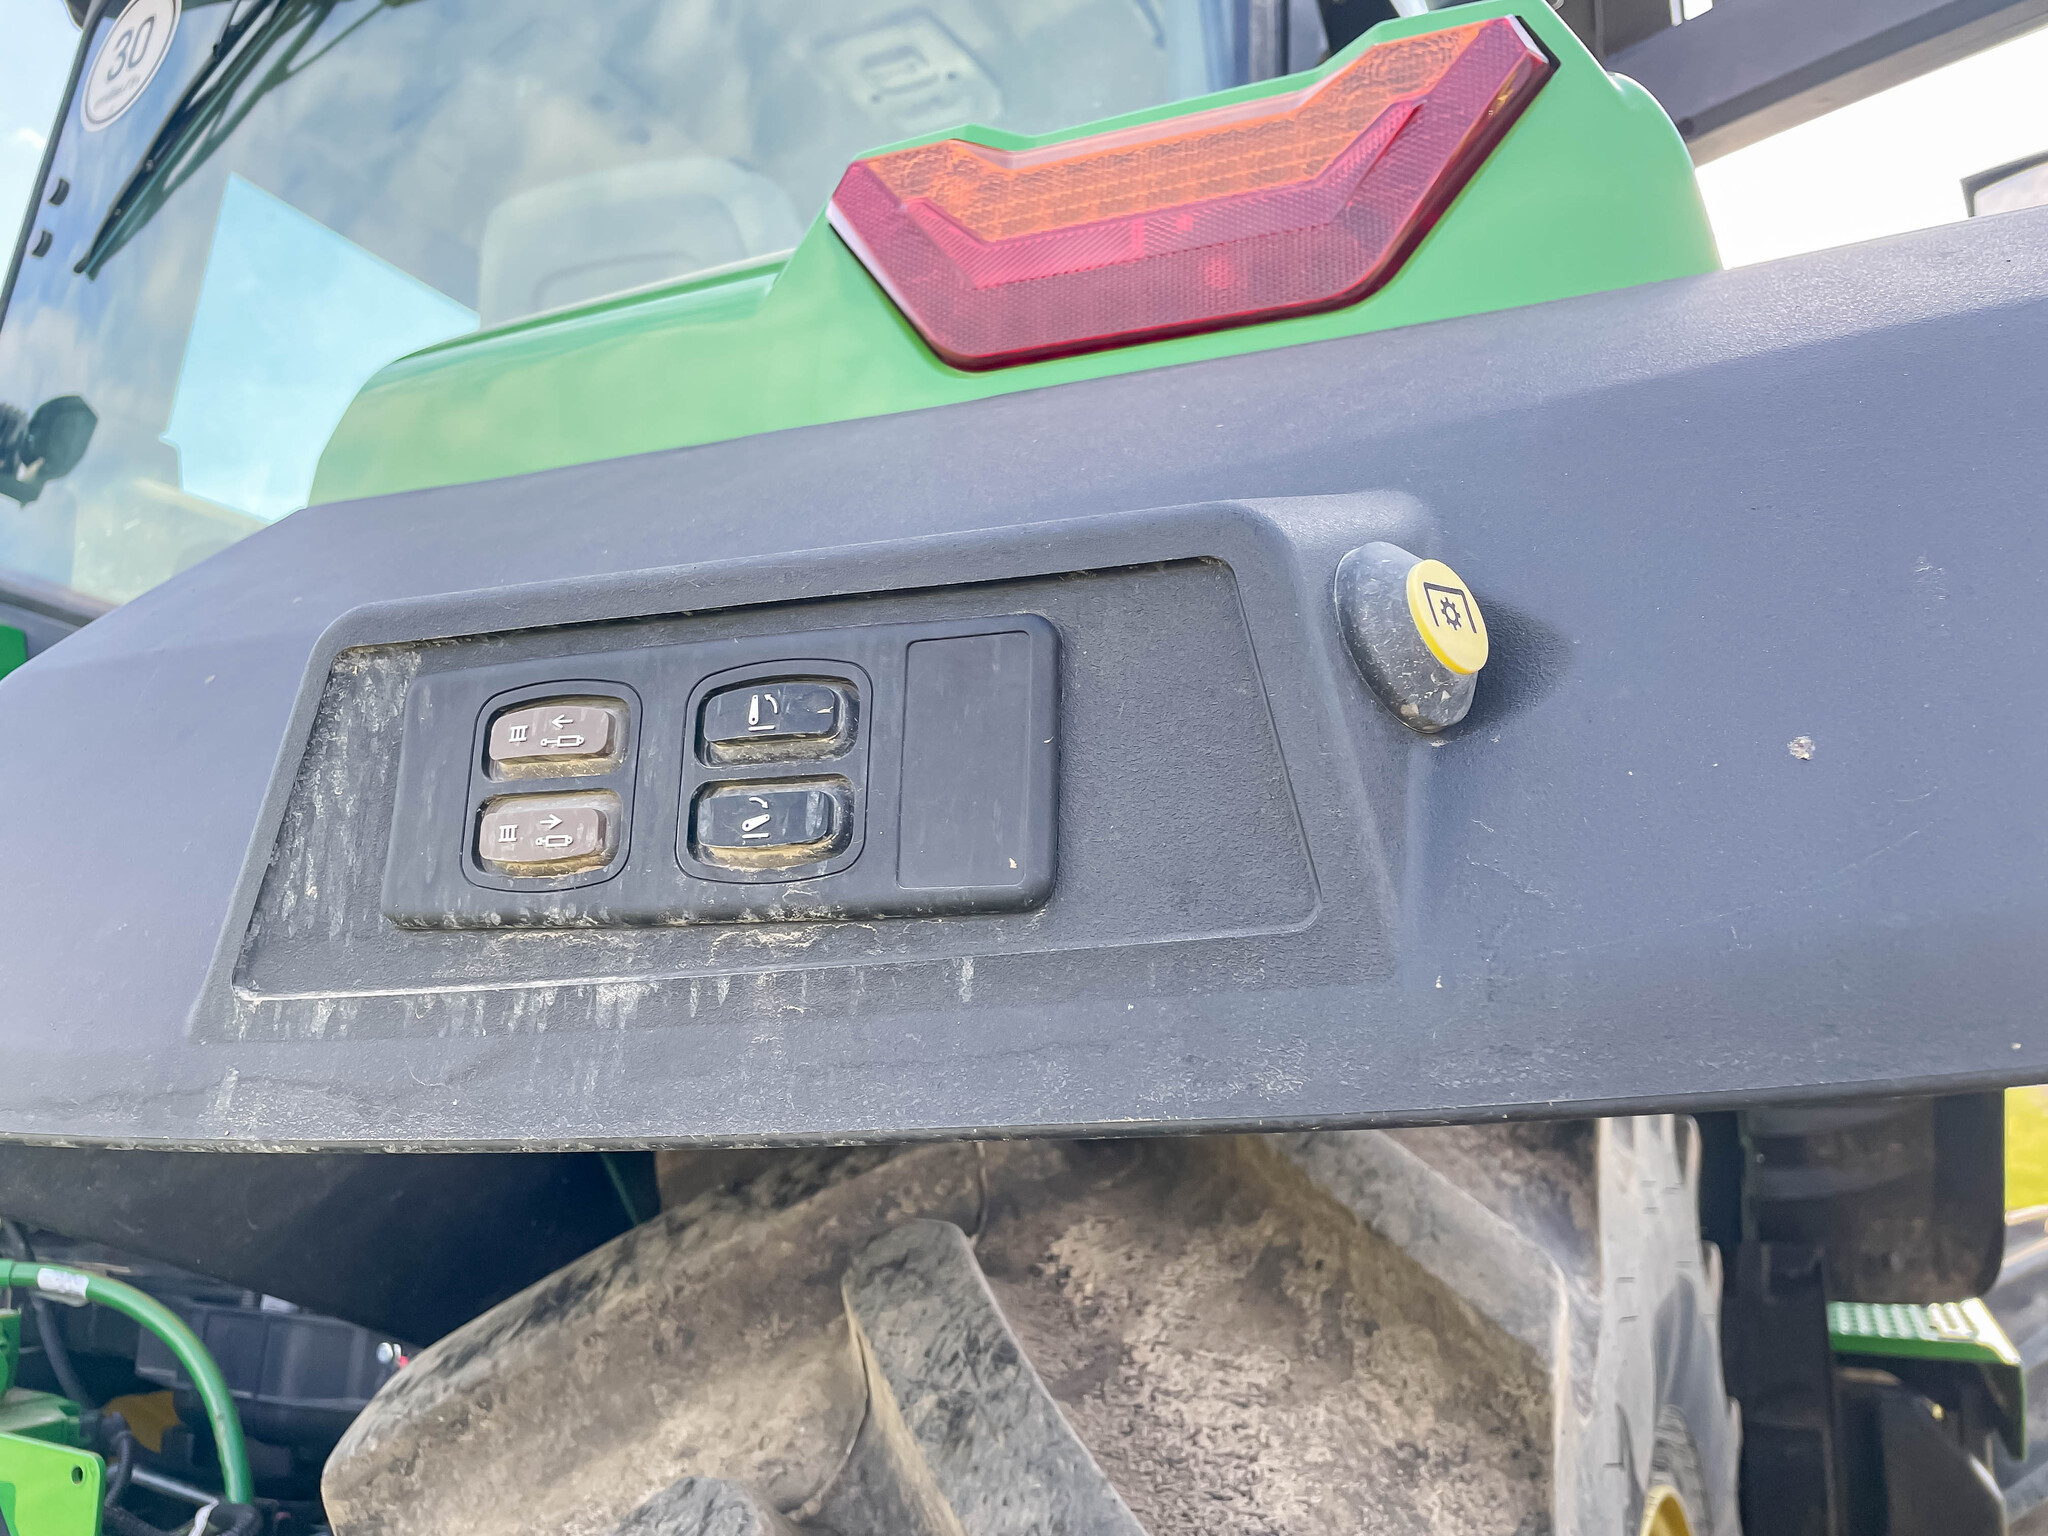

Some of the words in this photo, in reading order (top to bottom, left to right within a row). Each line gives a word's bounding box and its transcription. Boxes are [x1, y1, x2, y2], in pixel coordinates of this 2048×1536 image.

[106, 15, 156, 82] 30
[509, 725, 529, 743] III
[498, 824, 519, 843] III
